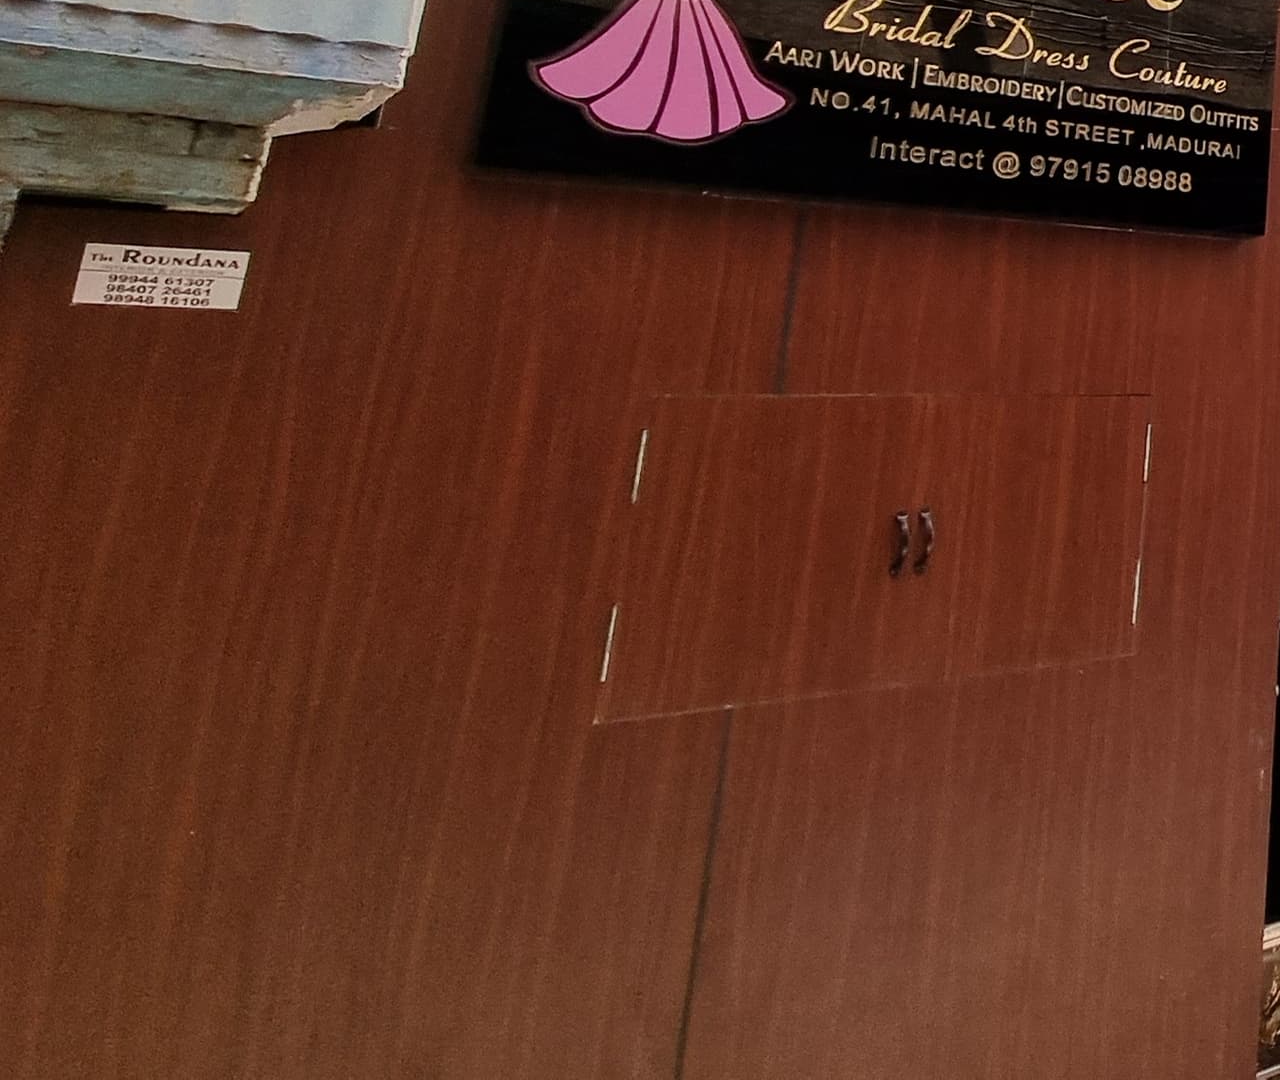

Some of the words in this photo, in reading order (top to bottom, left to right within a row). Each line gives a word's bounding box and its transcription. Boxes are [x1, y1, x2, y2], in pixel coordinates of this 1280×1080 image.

[975, 11, 1090, 72] Dress
[1109, 38, 1229, 94] Couture
[810, 87, 900, 118] NO.41,
[910, 100, 997, 129] MAHAL
[1002, 113, 1038, 135] 4th
[1045, 119, 1134, 146] STREET
[870, 135, 985, 171] Interact
[991, 151, 1022, 179] @
[1030, 155, 1110, 186] 97915
[1117, 165, 1192, 193] 08988
